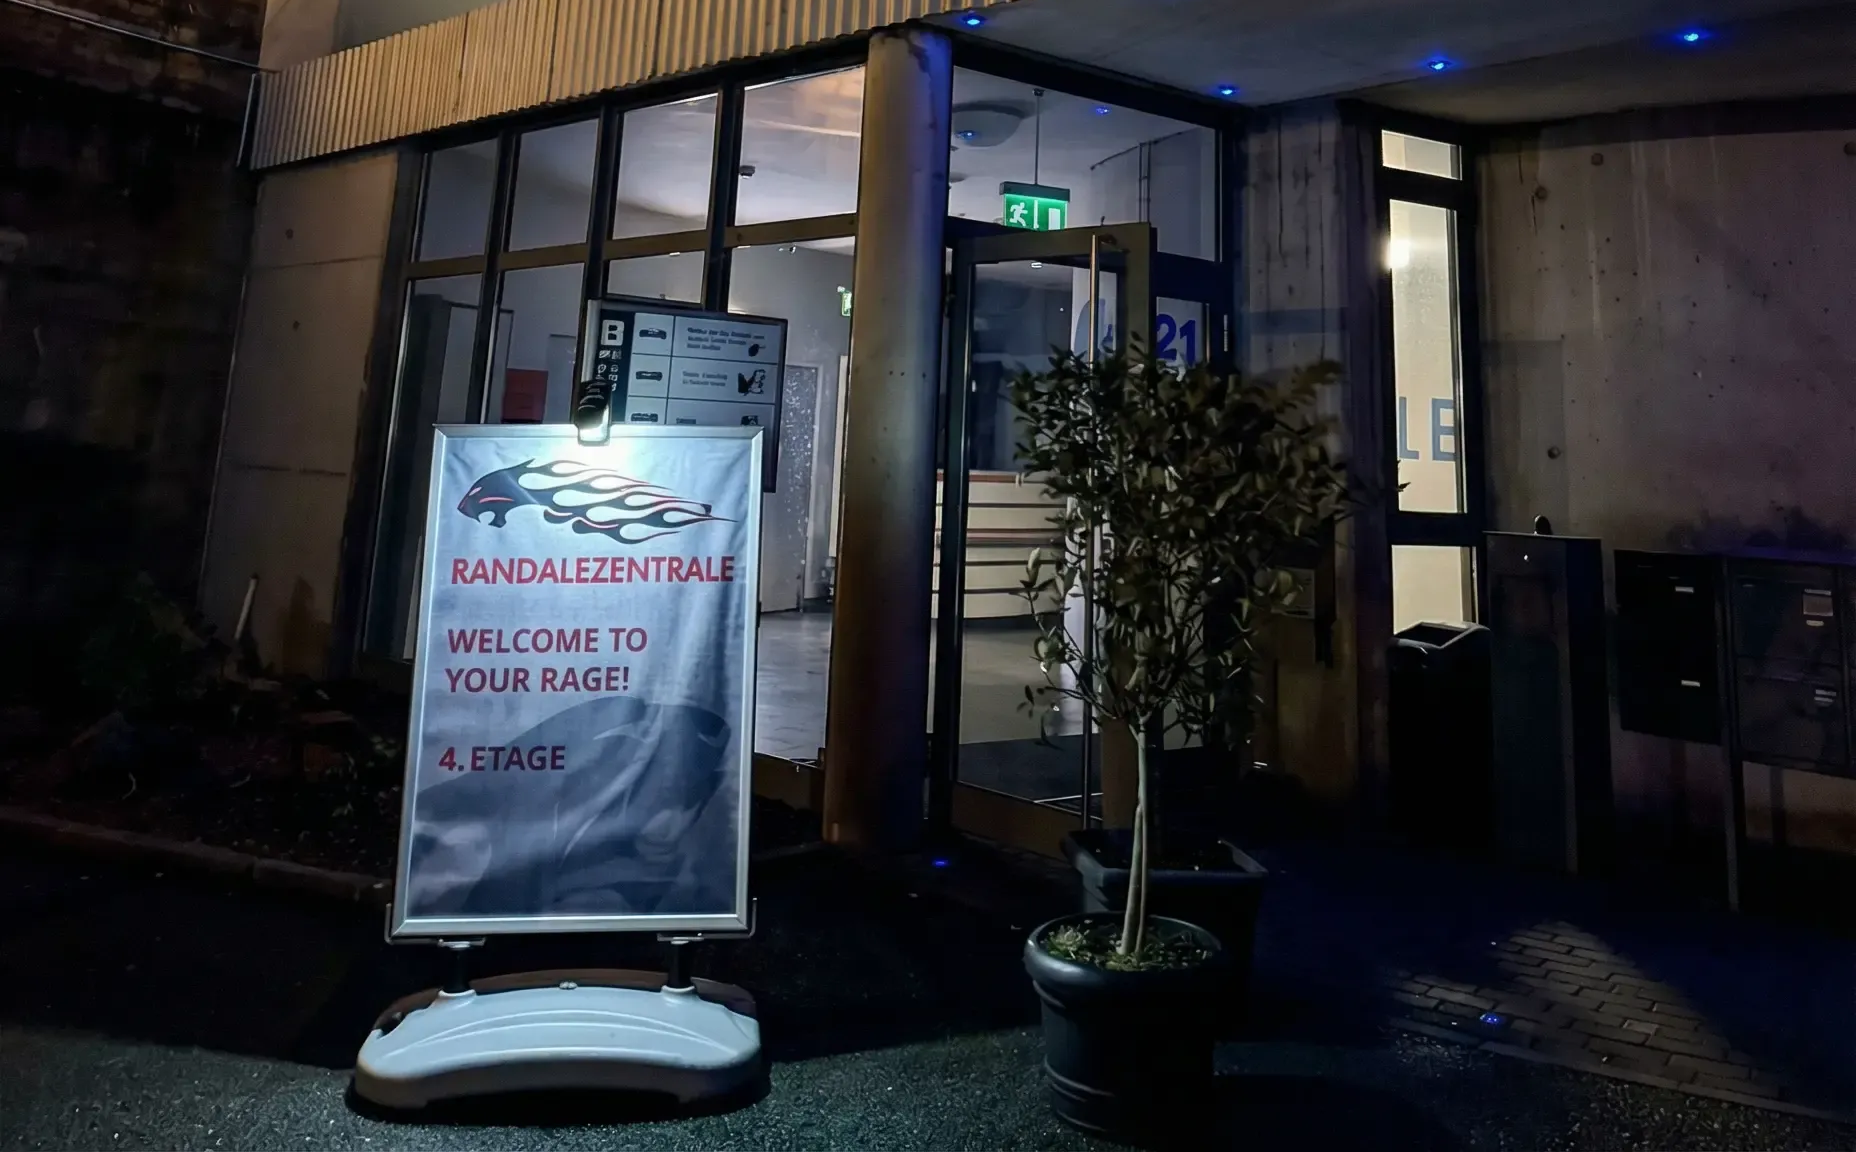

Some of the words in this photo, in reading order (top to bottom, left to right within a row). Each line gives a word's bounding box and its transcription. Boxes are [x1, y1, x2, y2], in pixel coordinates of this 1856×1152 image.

[451, 555, 735, 585] RANDALEZENTRALE
[447, 627, 600, 654] WELCOME
[608, 627, 648, 653] TO
[445, 667, 531, 693] YOUR
[540, 666, 630, 693] RAGE!
